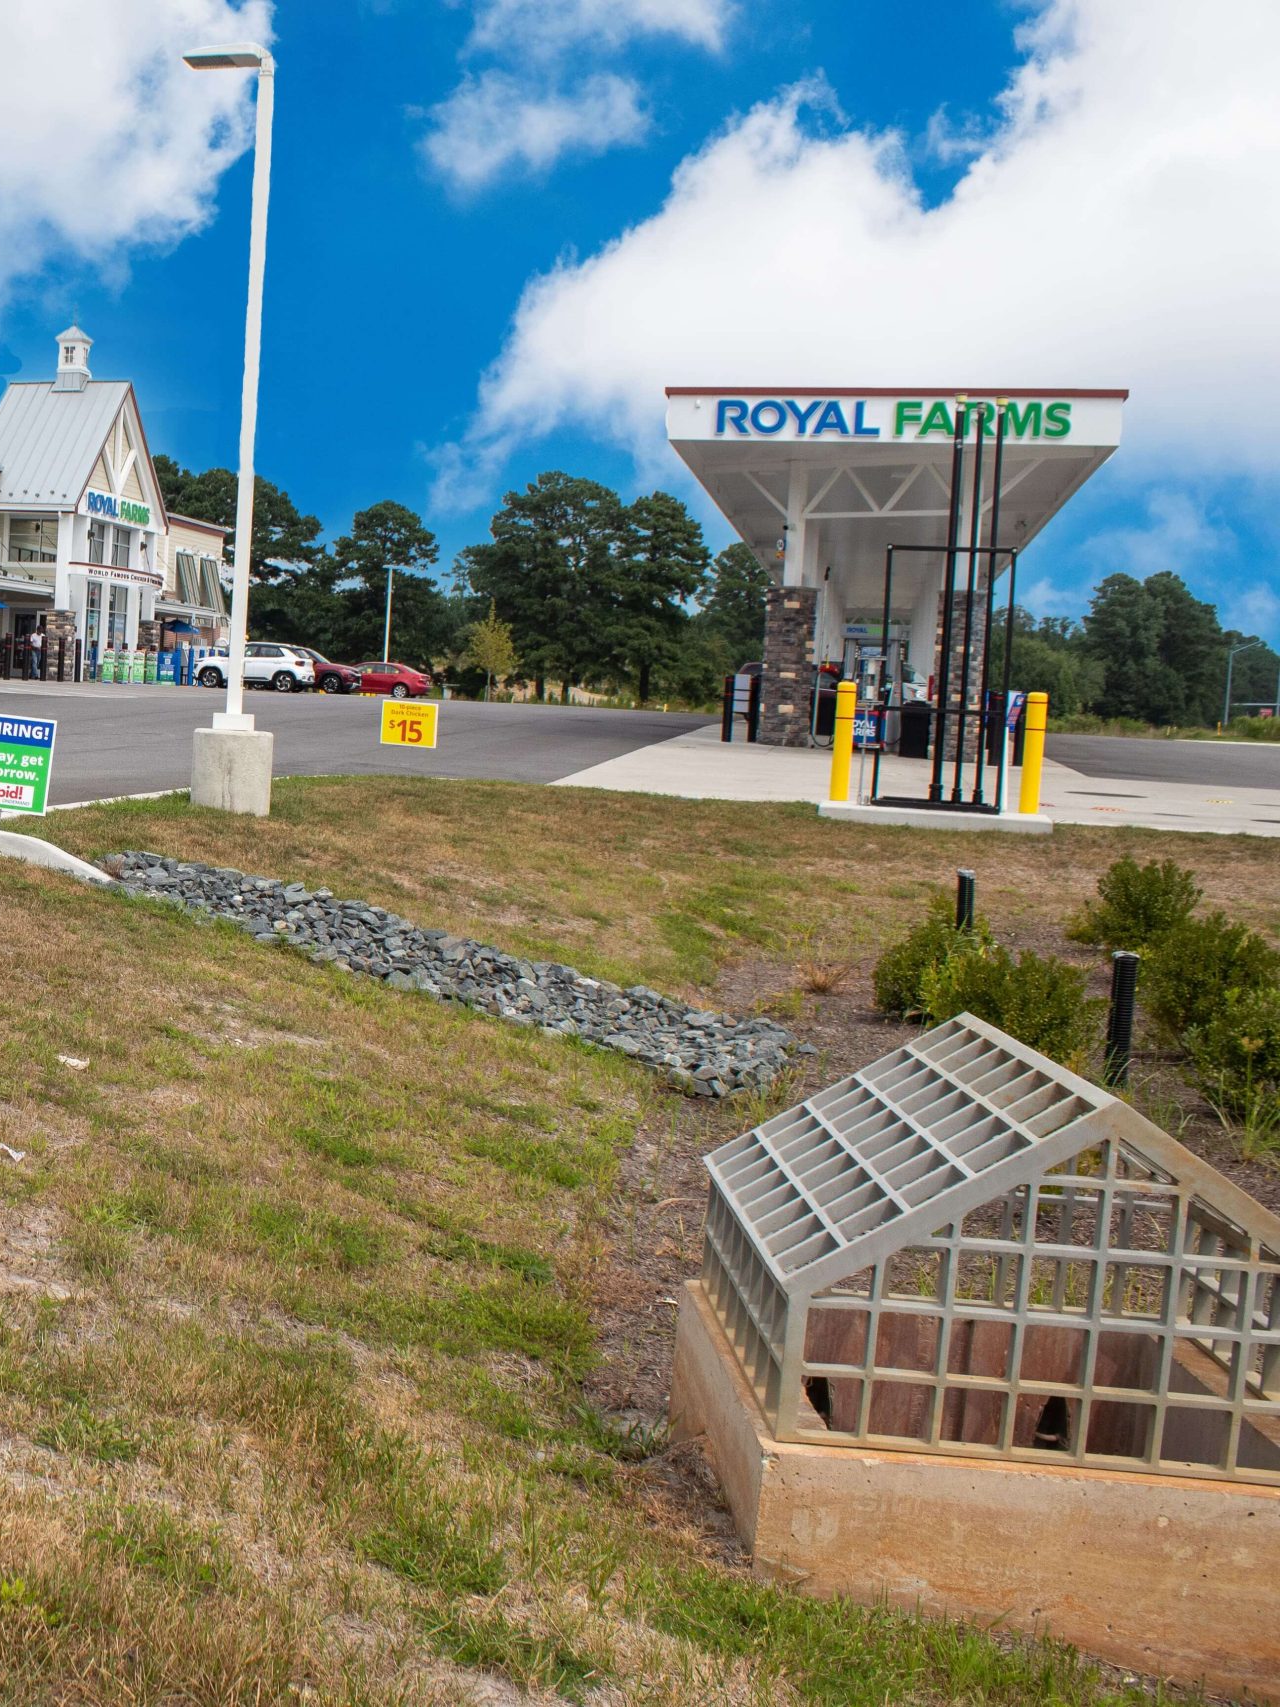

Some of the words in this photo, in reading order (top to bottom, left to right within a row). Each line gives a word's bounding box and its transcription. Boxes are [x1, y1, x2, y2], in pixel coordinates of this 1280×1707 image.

[714, 399, 880, 437] ROYAL
[892, 401, 1073, 439] FARMS
[88, 491, 118, 517] ROYAL
[120, 500, 150, 525] FARMS
[88, 568, 109, 576] WORLD
[389, 720, 423, 743] $15
[852, 719, 876, 728] OYAL
[21, 755, 44, 767] get
